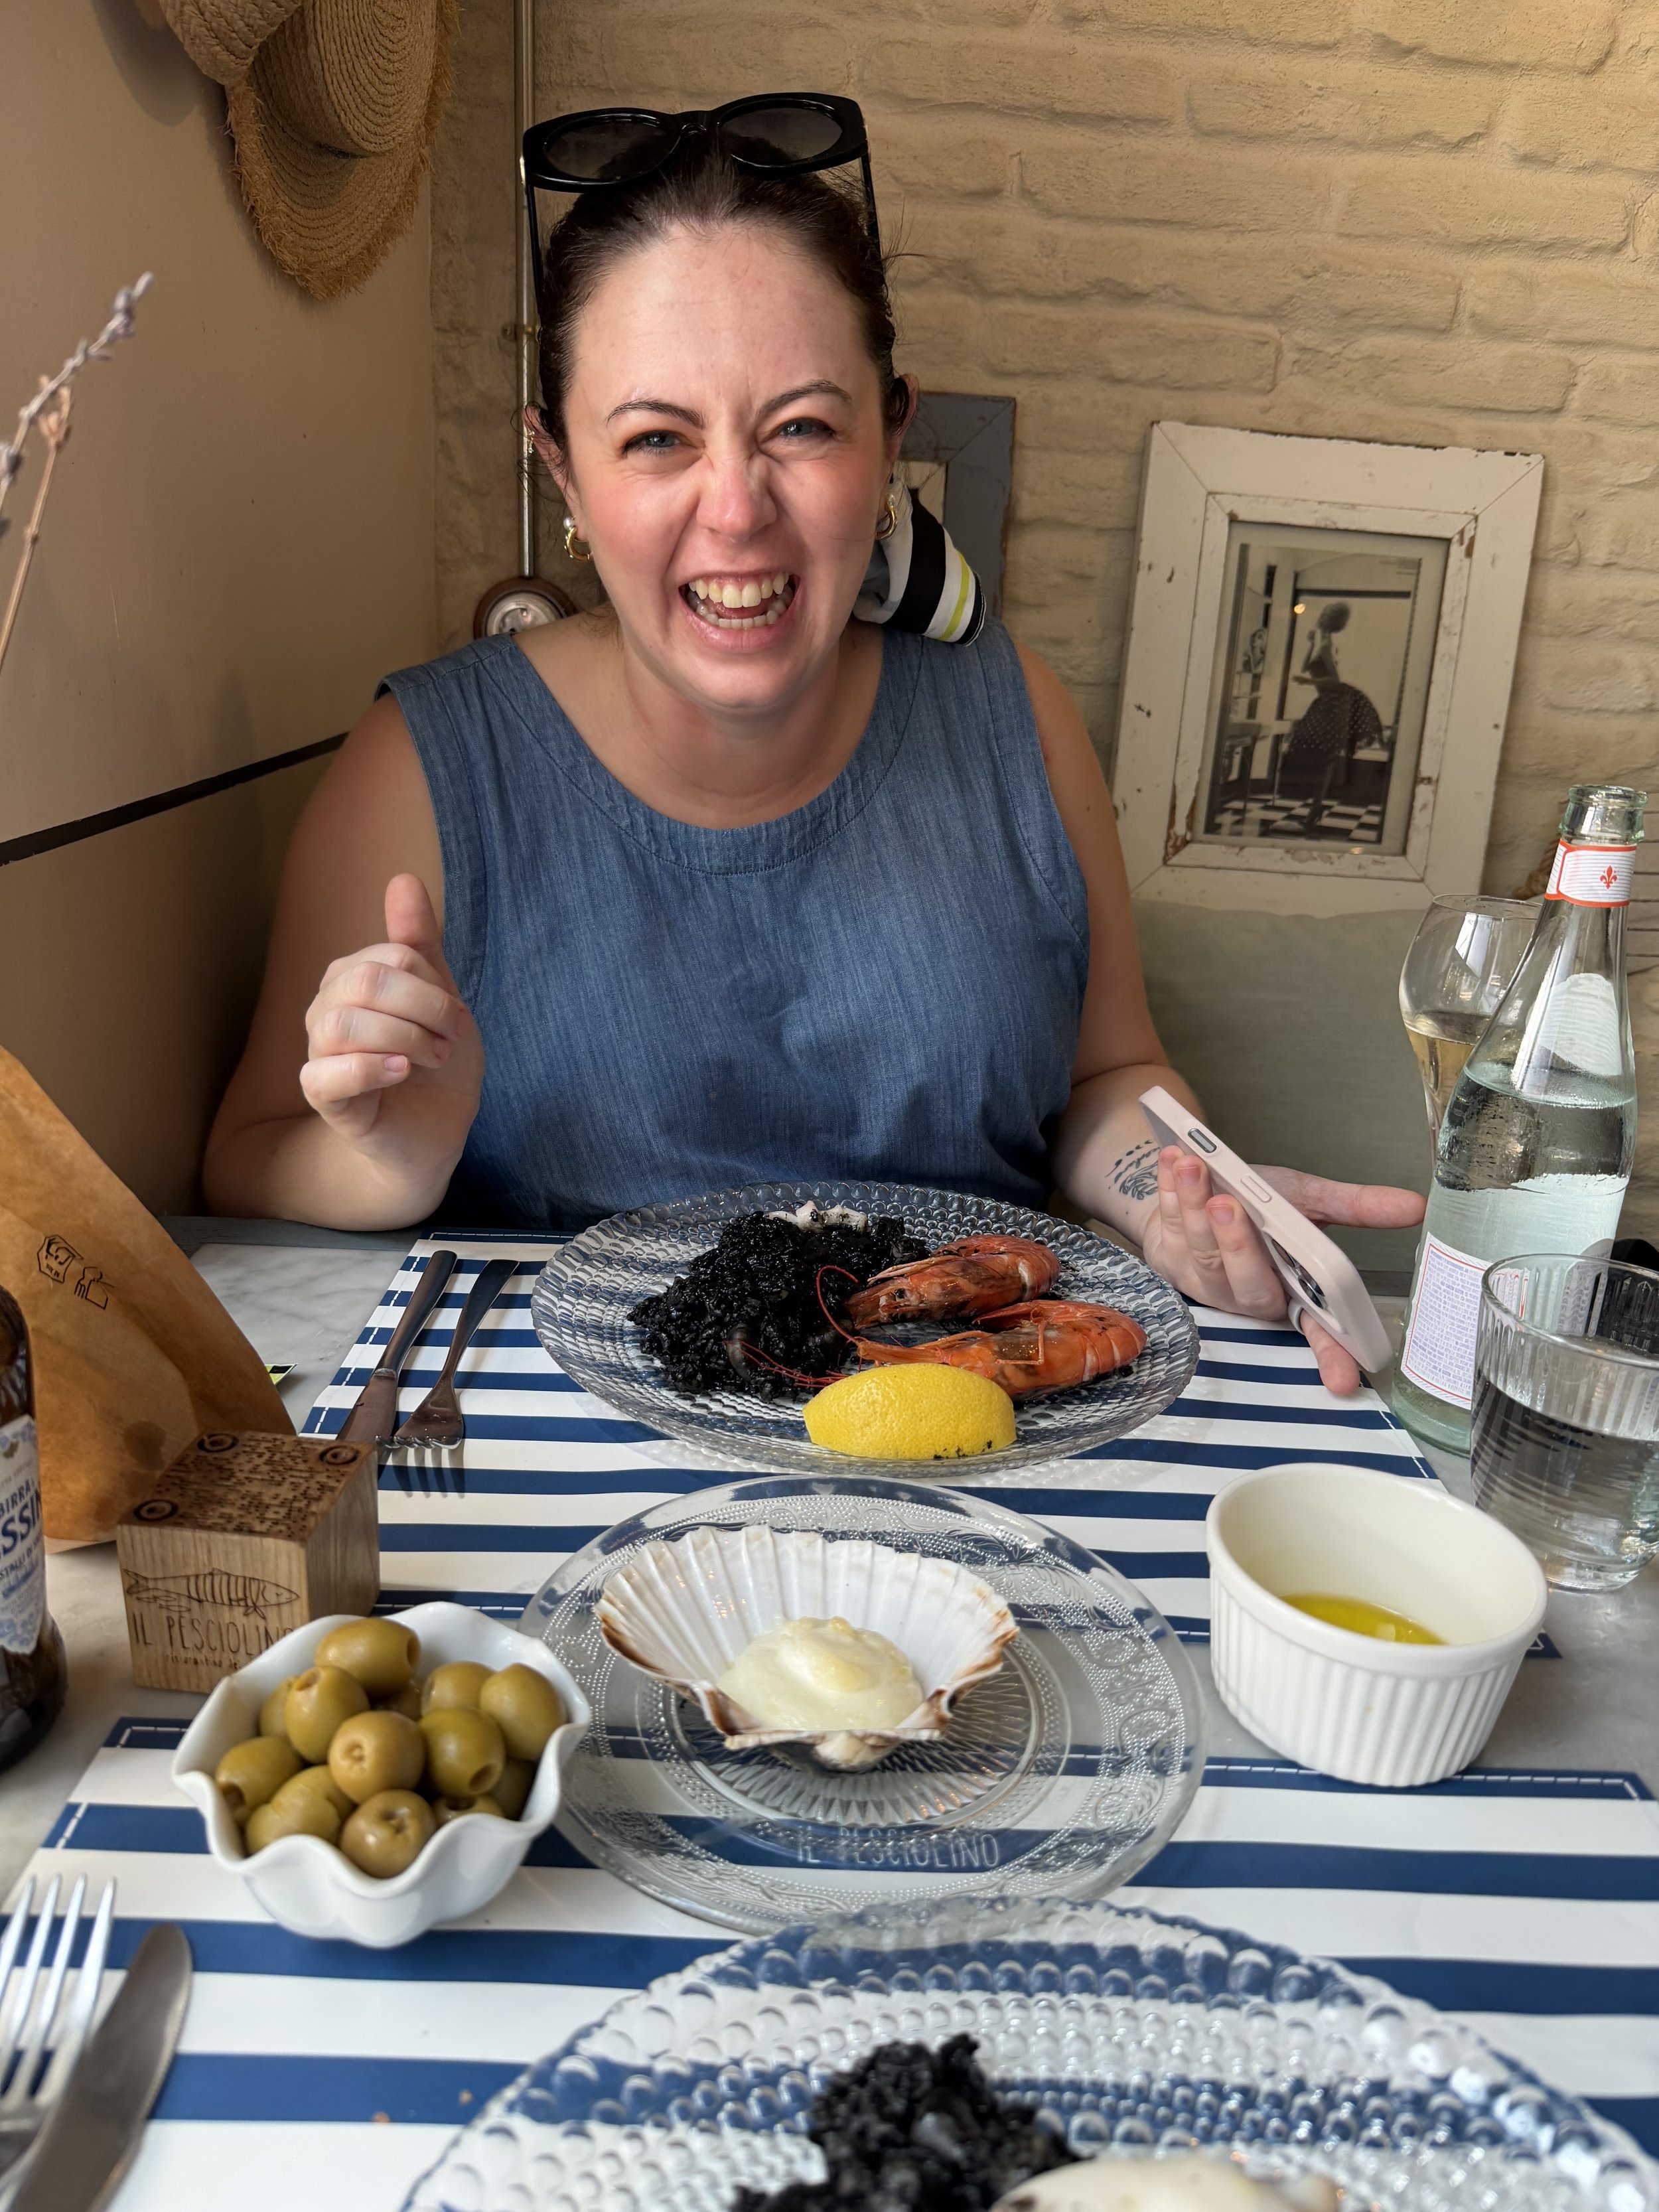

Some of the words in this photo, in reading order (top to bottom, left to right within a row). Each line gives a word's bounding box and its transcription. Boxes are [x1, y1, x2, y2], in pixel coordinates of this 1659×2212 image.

[0, 1488, 40, 1556] SSIN
[133, 1612, 153, 1646] IL
[167, 1612, 293, 1656] PESCIOLIN
